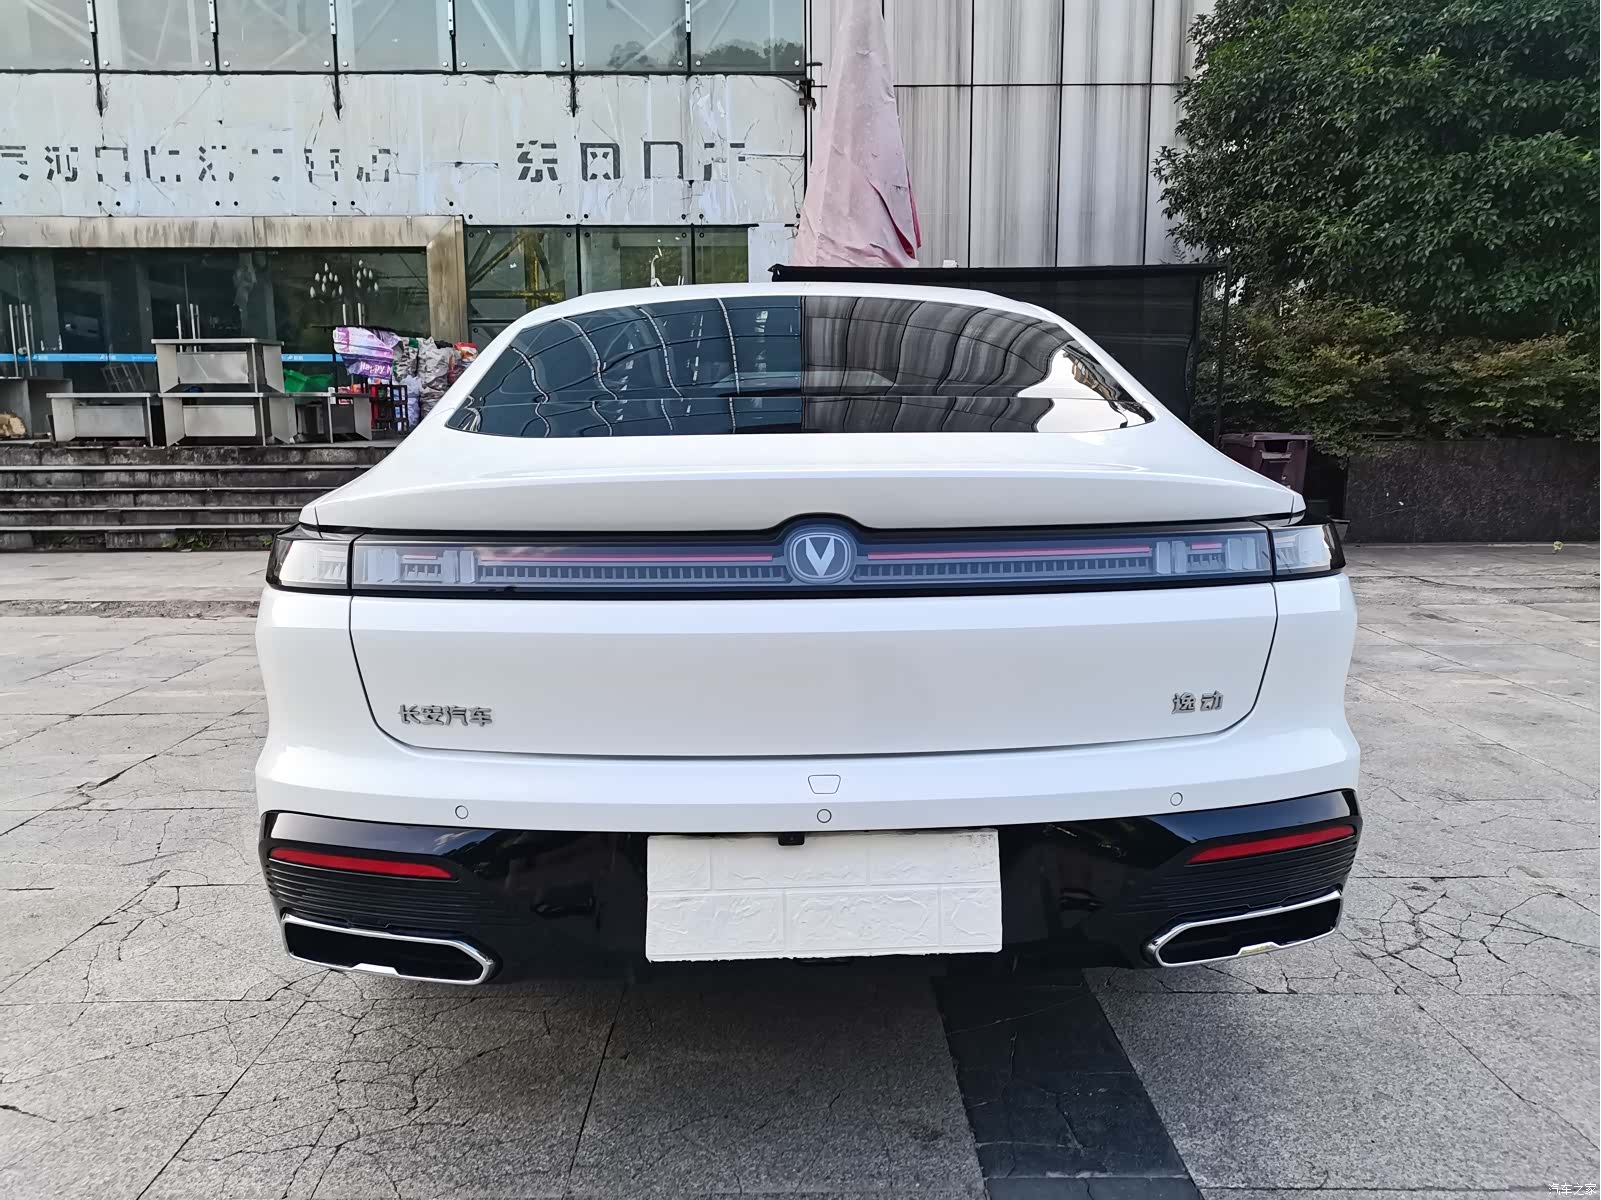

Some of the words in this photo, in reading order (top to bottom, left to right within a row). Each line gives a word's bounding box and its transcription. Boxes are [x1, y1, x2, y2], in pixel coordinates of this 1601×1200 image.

[1171, 690, 1224, 715] 逸动
[398, 703, 493, 727] 长安汽车
